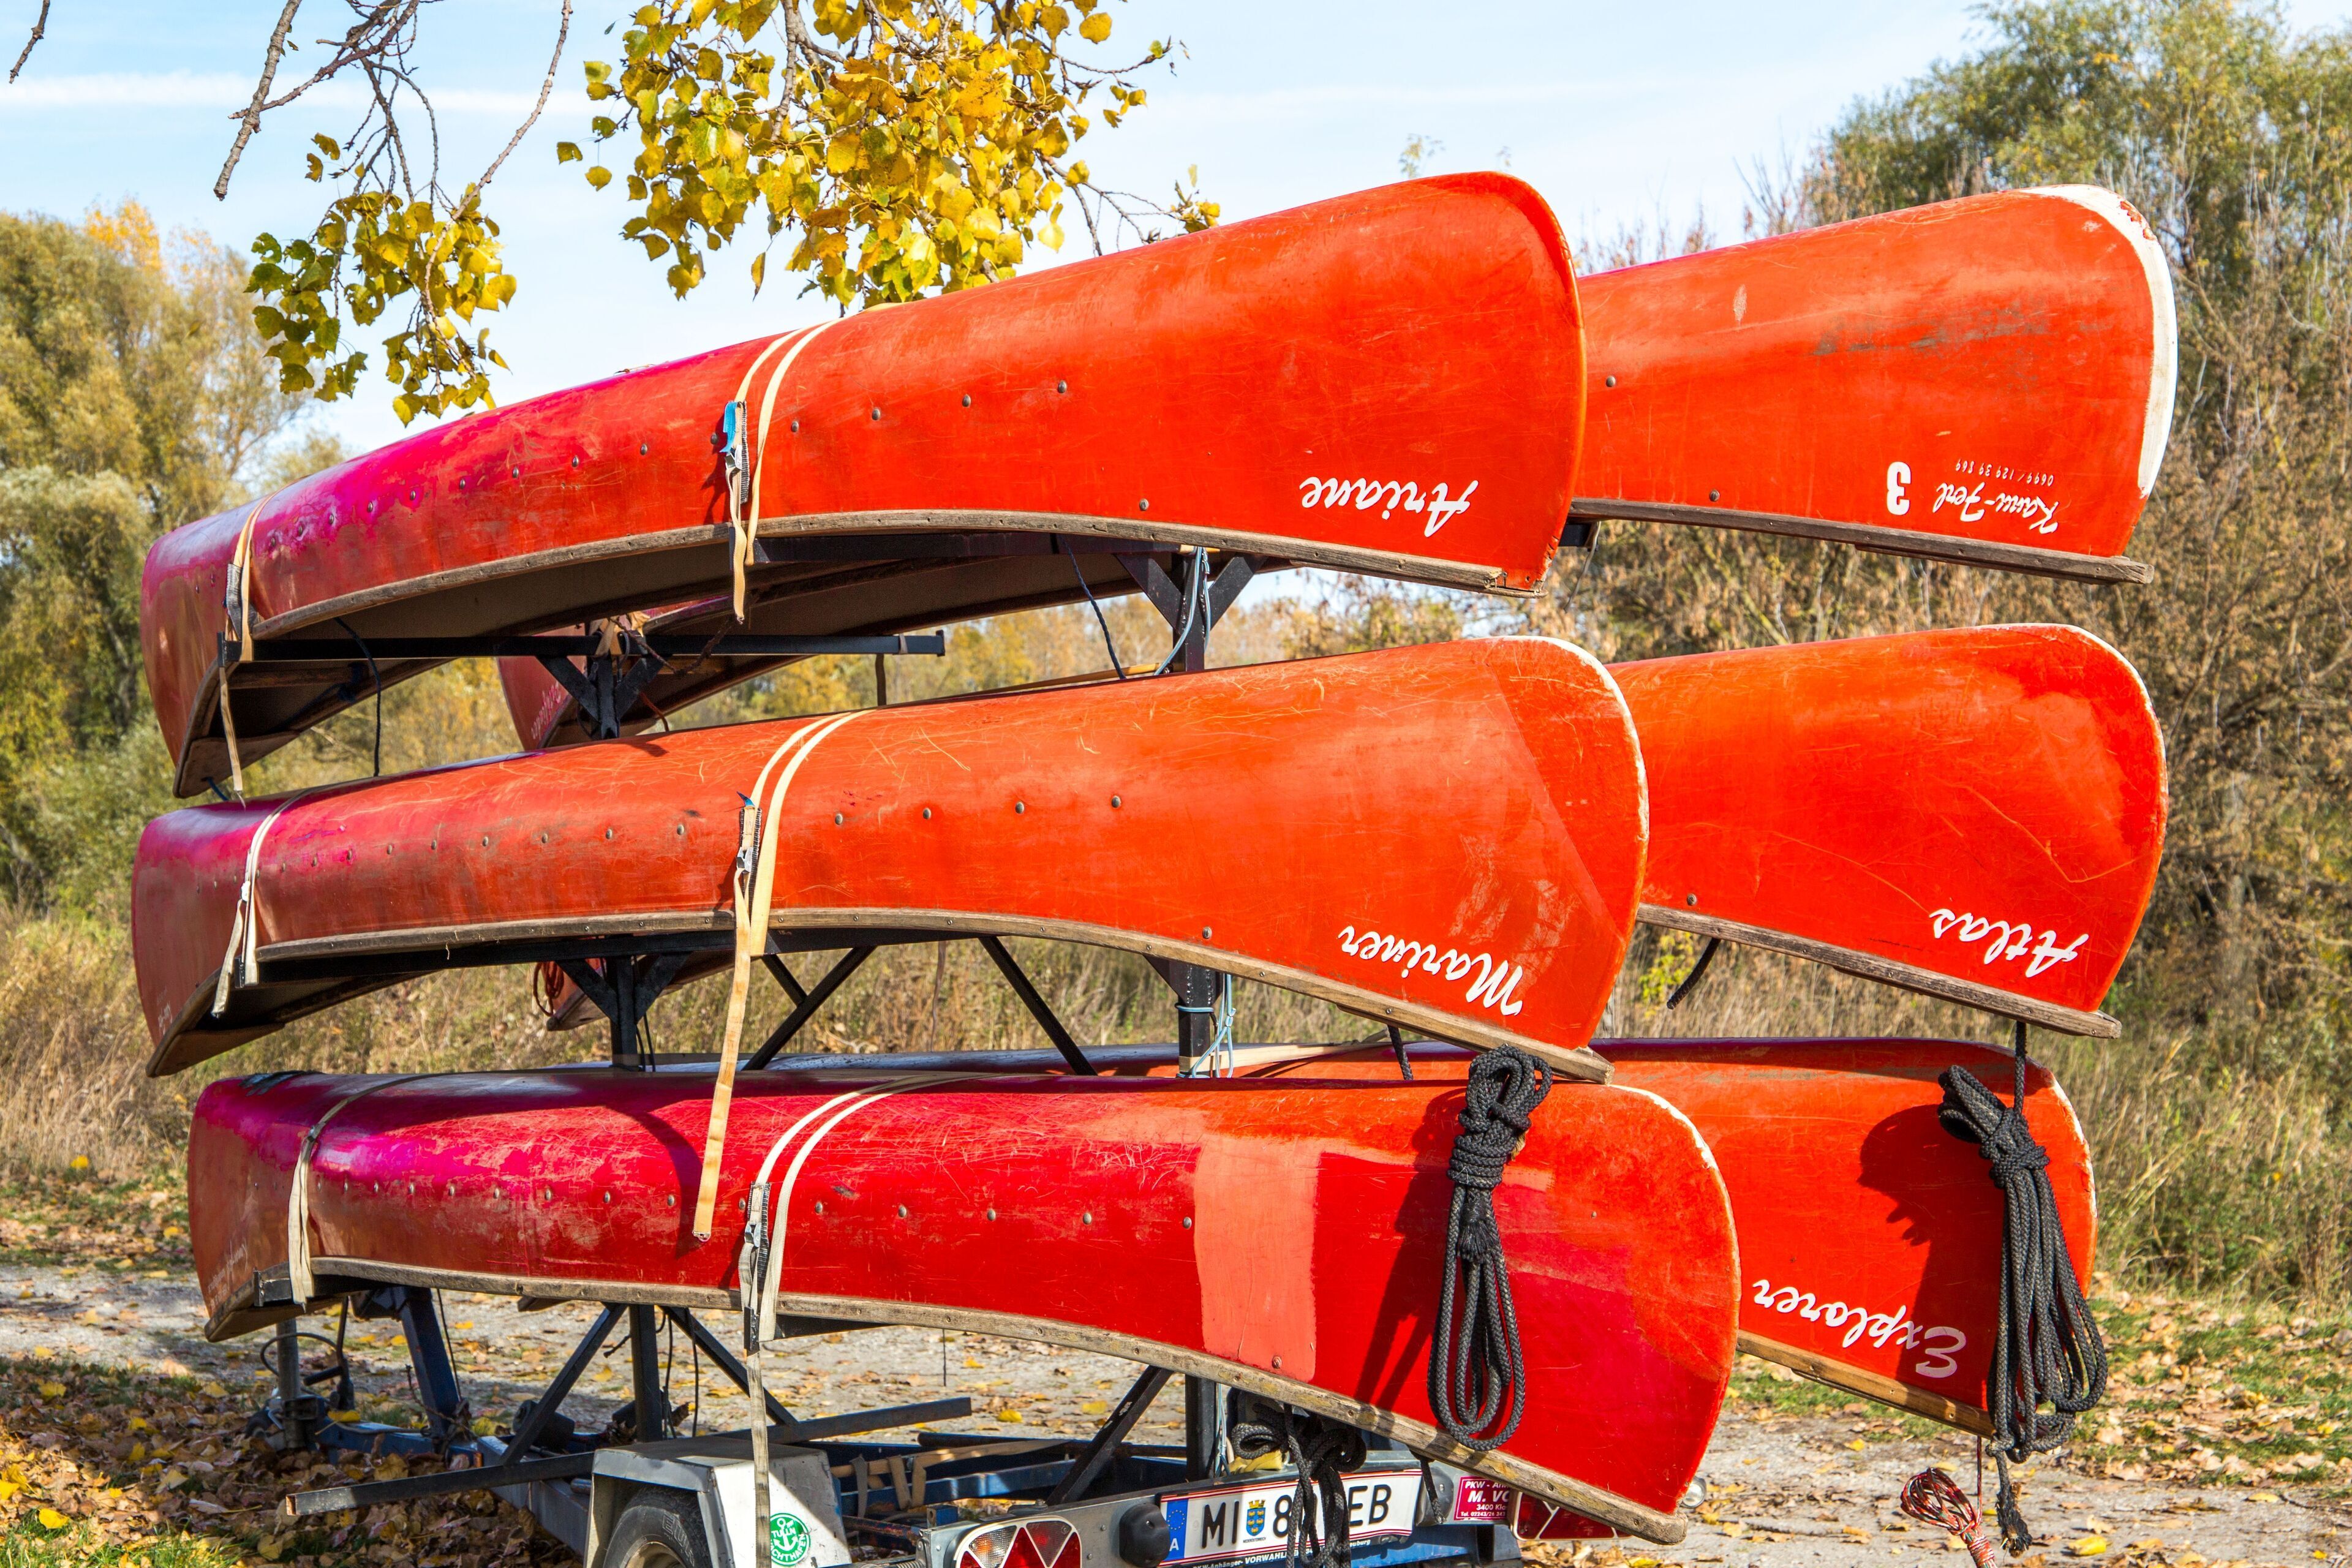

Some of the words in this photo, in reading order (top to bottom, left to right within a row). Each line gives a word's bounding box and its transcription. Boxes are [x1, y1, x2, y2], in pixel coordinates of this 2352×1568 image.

[1887, 461, 1912, 516] 3
[1955, 458, 1975, 473] 869
[1298, 476, 1479, 538] Ariane
[1336, 924, 1523, 1017] Mariner
[1929, 908, 2090, 979] Atlas
[1752, 1278, 1967, 1379] Explorer
[1200, 1501, 1240, 1549] MI
[1348, 1483, 1392, 1528] EB
[1468, 1490, 1486, 1502] M.
[771, 1533, 807, 1562] ACHTHAFEN
[1169, 1538, 1179, 1551] A
